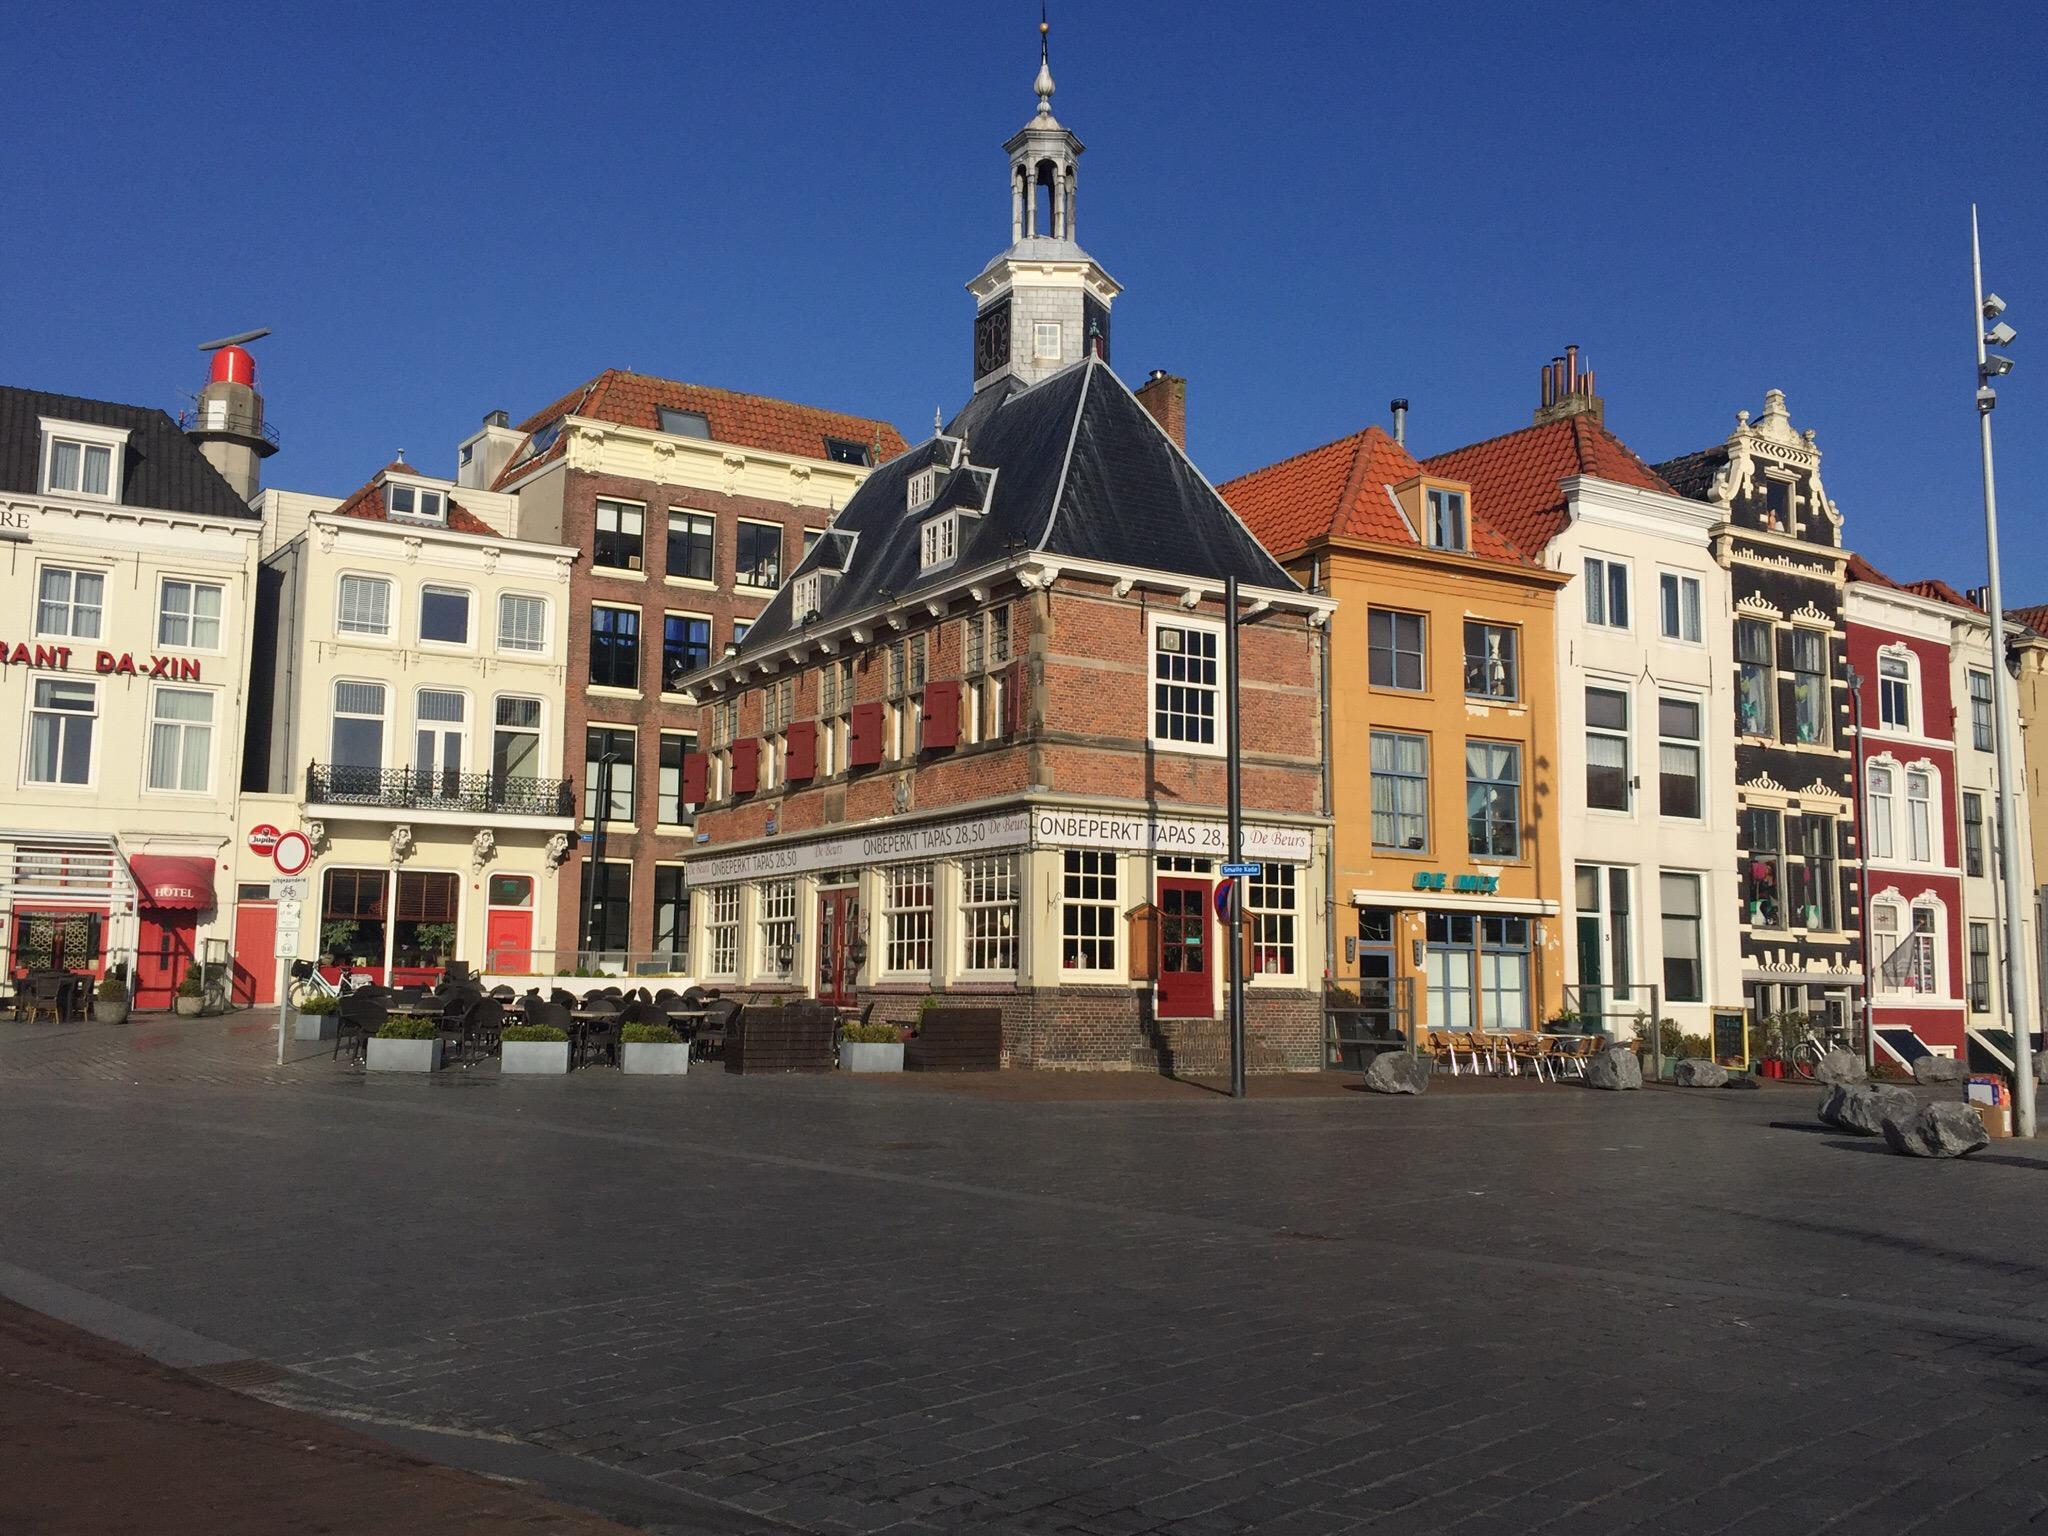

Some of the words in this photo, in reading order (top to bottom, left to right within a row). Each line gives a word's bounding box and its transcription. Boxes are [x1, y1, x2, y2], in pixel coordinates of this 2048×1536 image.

[96, 651, 200, 682] DA-XIN
[863, 832, 919, 856] ONBEPERKT
[922, 828, 952, 848] TAPAS
[955, 823, 985, 845] 28,50
[988, 820, 1001, 834] De
[1003, 816, 1028, 832] Beurs
[1040, 817, 1142, 841] ONBEPERKT
[1150, 823, 1195, 845] TAPAS
[1202, 828, 1245, 848] 28,
[1251, 830, 1268, 845] De
[1271, 831, 1306, 848] Beurs
[711, 857, 751, 877] ONBEPERKT
[752, 852, 774, 871] TAPAS
[776, 850, 797, 869] 28,50
[155, 887, 194, 899] HOTEL
[1413, 871, 1447, 891] DE
[1605, 933, 1610, 942] 3
